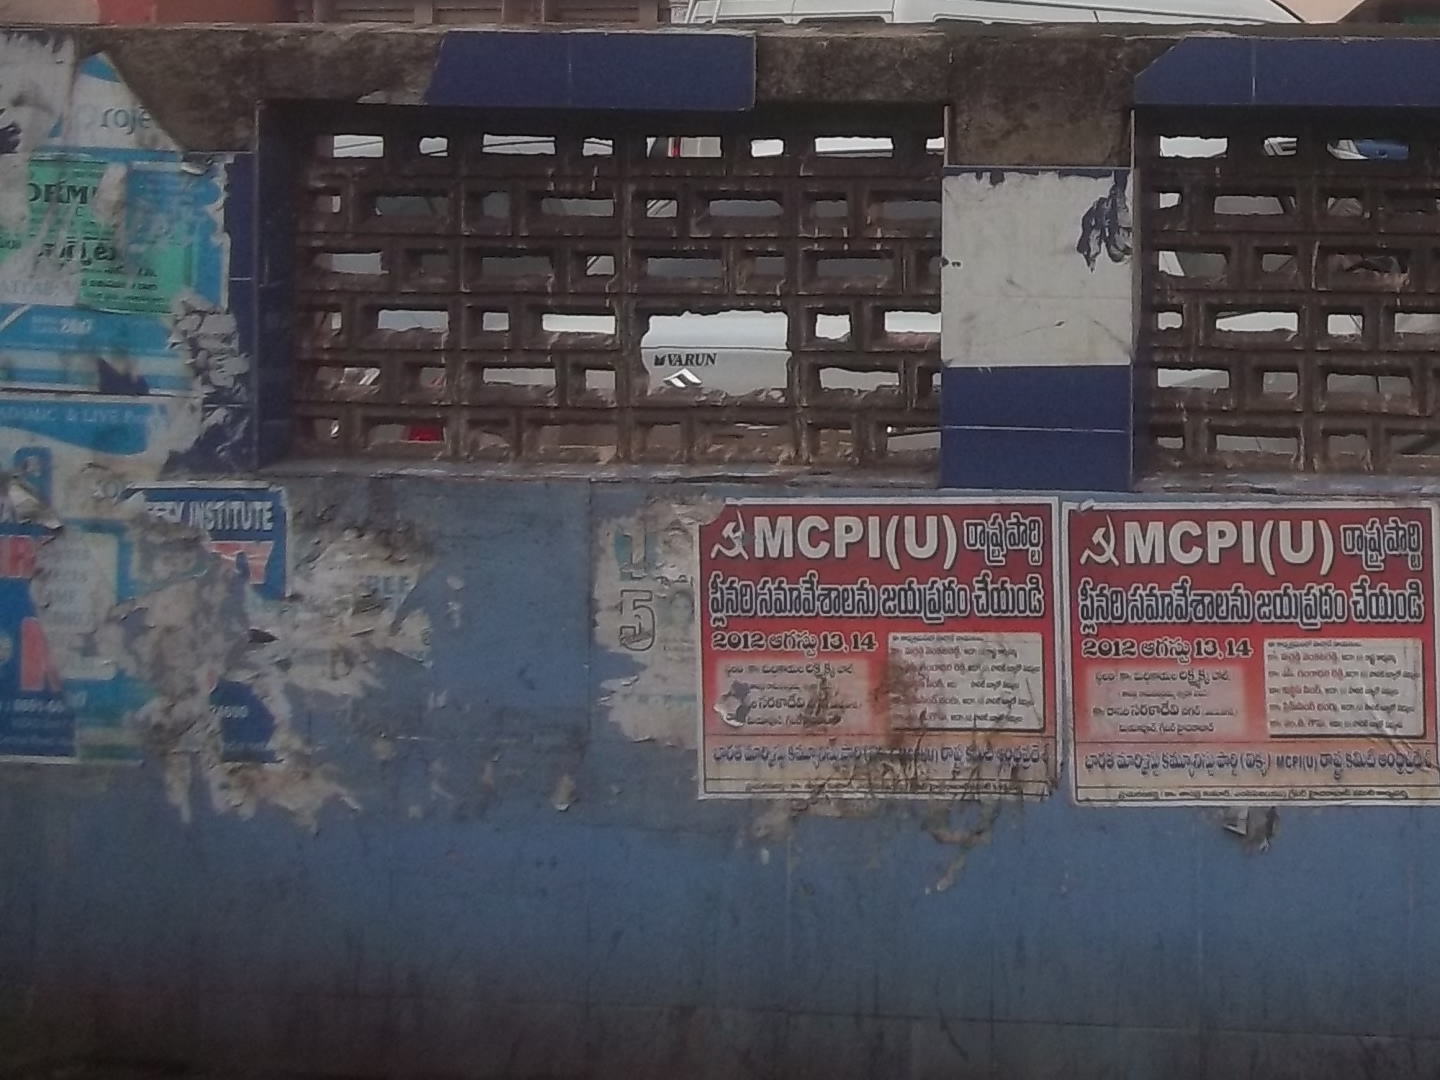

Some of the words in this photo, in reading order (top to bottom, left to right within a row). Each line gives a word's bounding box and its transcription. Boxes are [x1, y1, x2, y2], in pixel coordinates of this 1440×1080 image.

[667, 352, 718, 367] VARUN
[188, 501, 274, 531] INSTITUTE
[752, 515, 958, 570] MCPI(U)
[1124, 519, 1336, 576] MCPI(U)
[711, 631, 765, 651] 2012
[1083, 639, 1137, 659] 2012
